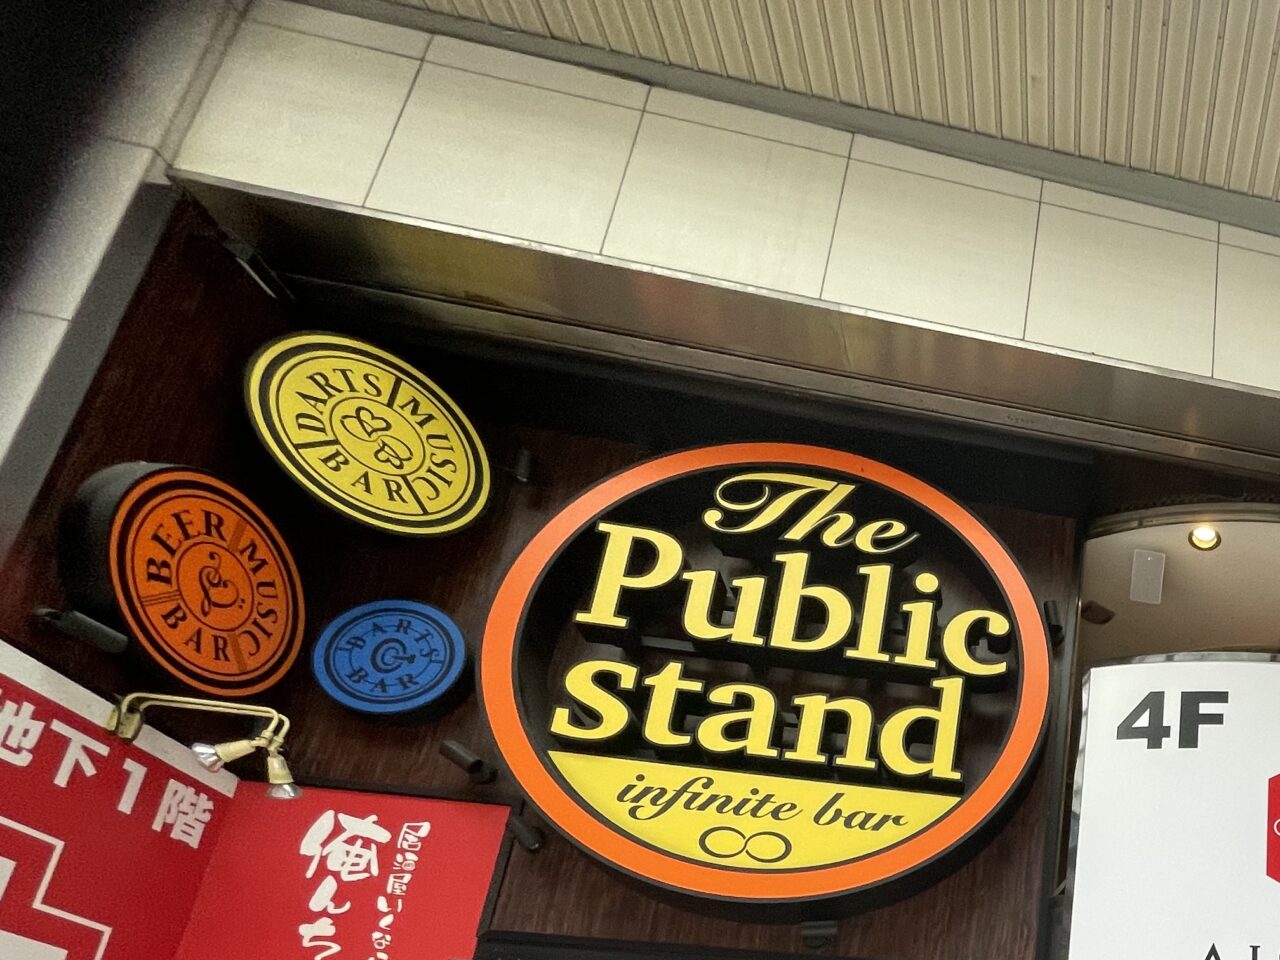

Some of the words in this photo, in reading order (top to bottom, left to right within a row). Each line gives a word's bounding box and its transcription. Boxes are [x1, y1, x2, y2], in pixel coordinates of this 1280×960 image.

[297, 368, 382, 433] DARTS
[319, 450, 408, 504] BAR
[397, 395, 457, 502] MUSIC
[146, 508, 225, 586] BEER
[702, 472, 921, 556] The
[162, 603, 230, 662] BAR
[239, 539, 278, 657] MUSIC
[574, 521, 1011, 678] Public
[348, 667, 418, 696] BAR
[549, 659, 966, 782] stand
[1115, 690, 1230, 750] 4F
[0, 698, 215, 850] 地下1階
[615, 772, 803, 822] infinite
[812, 791, 908, 832] bar
